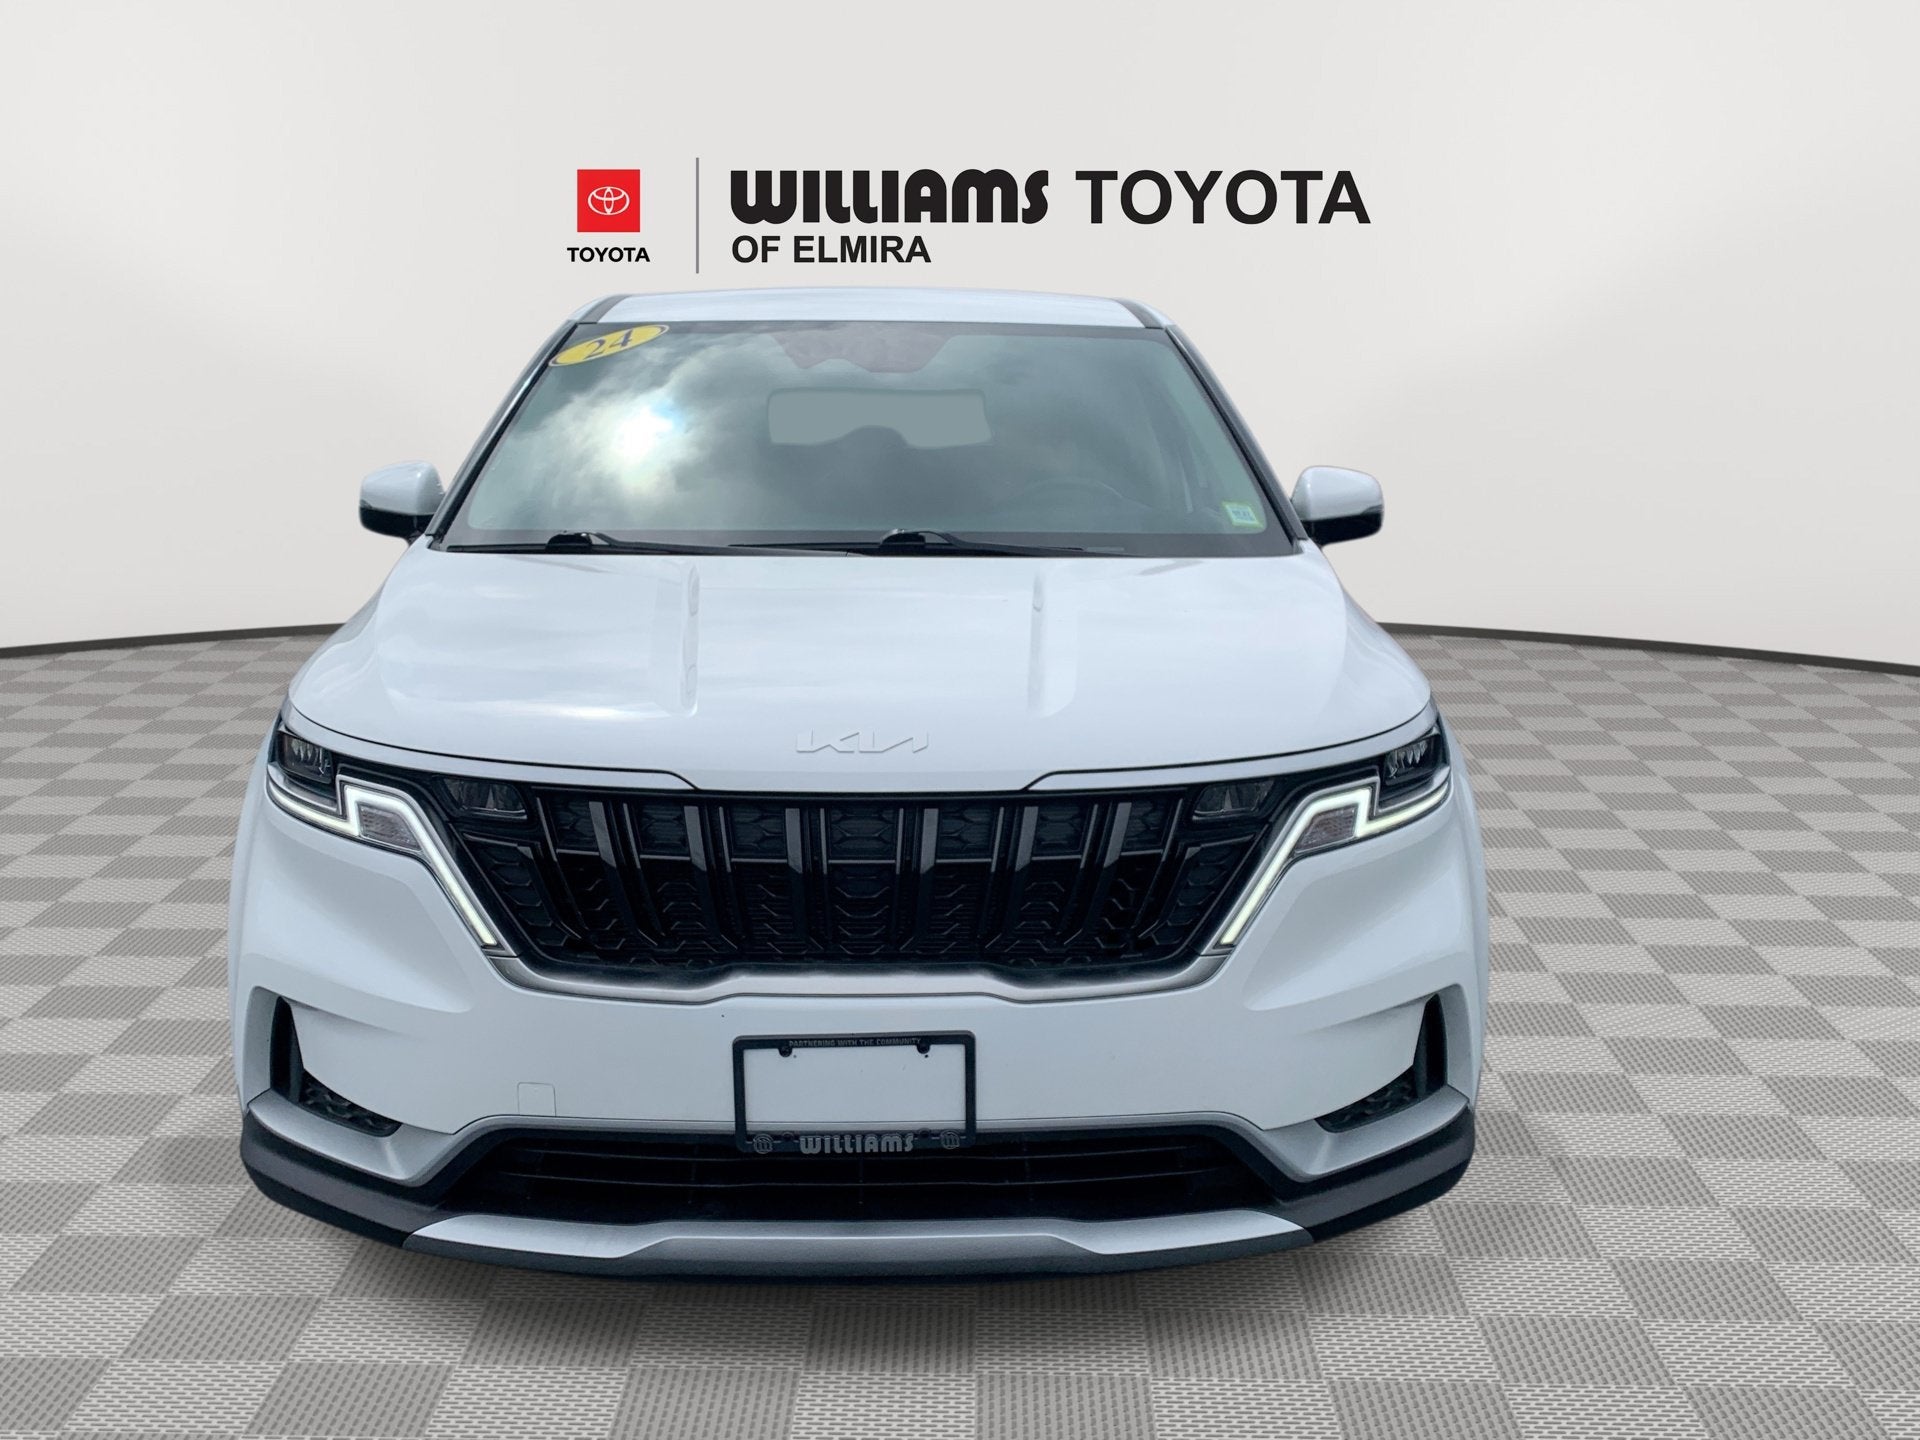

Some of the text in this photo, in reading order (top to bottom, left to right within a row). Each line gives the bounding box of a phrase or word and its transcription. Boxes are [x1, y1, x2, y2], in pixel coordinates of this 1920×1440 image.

[582, 328, 634, 361] 24
[788, 1037, 921, 1048] PARTNERING WITH THE COMMUNITY
[800, 1133, 914, 1154] WILLIAMS
